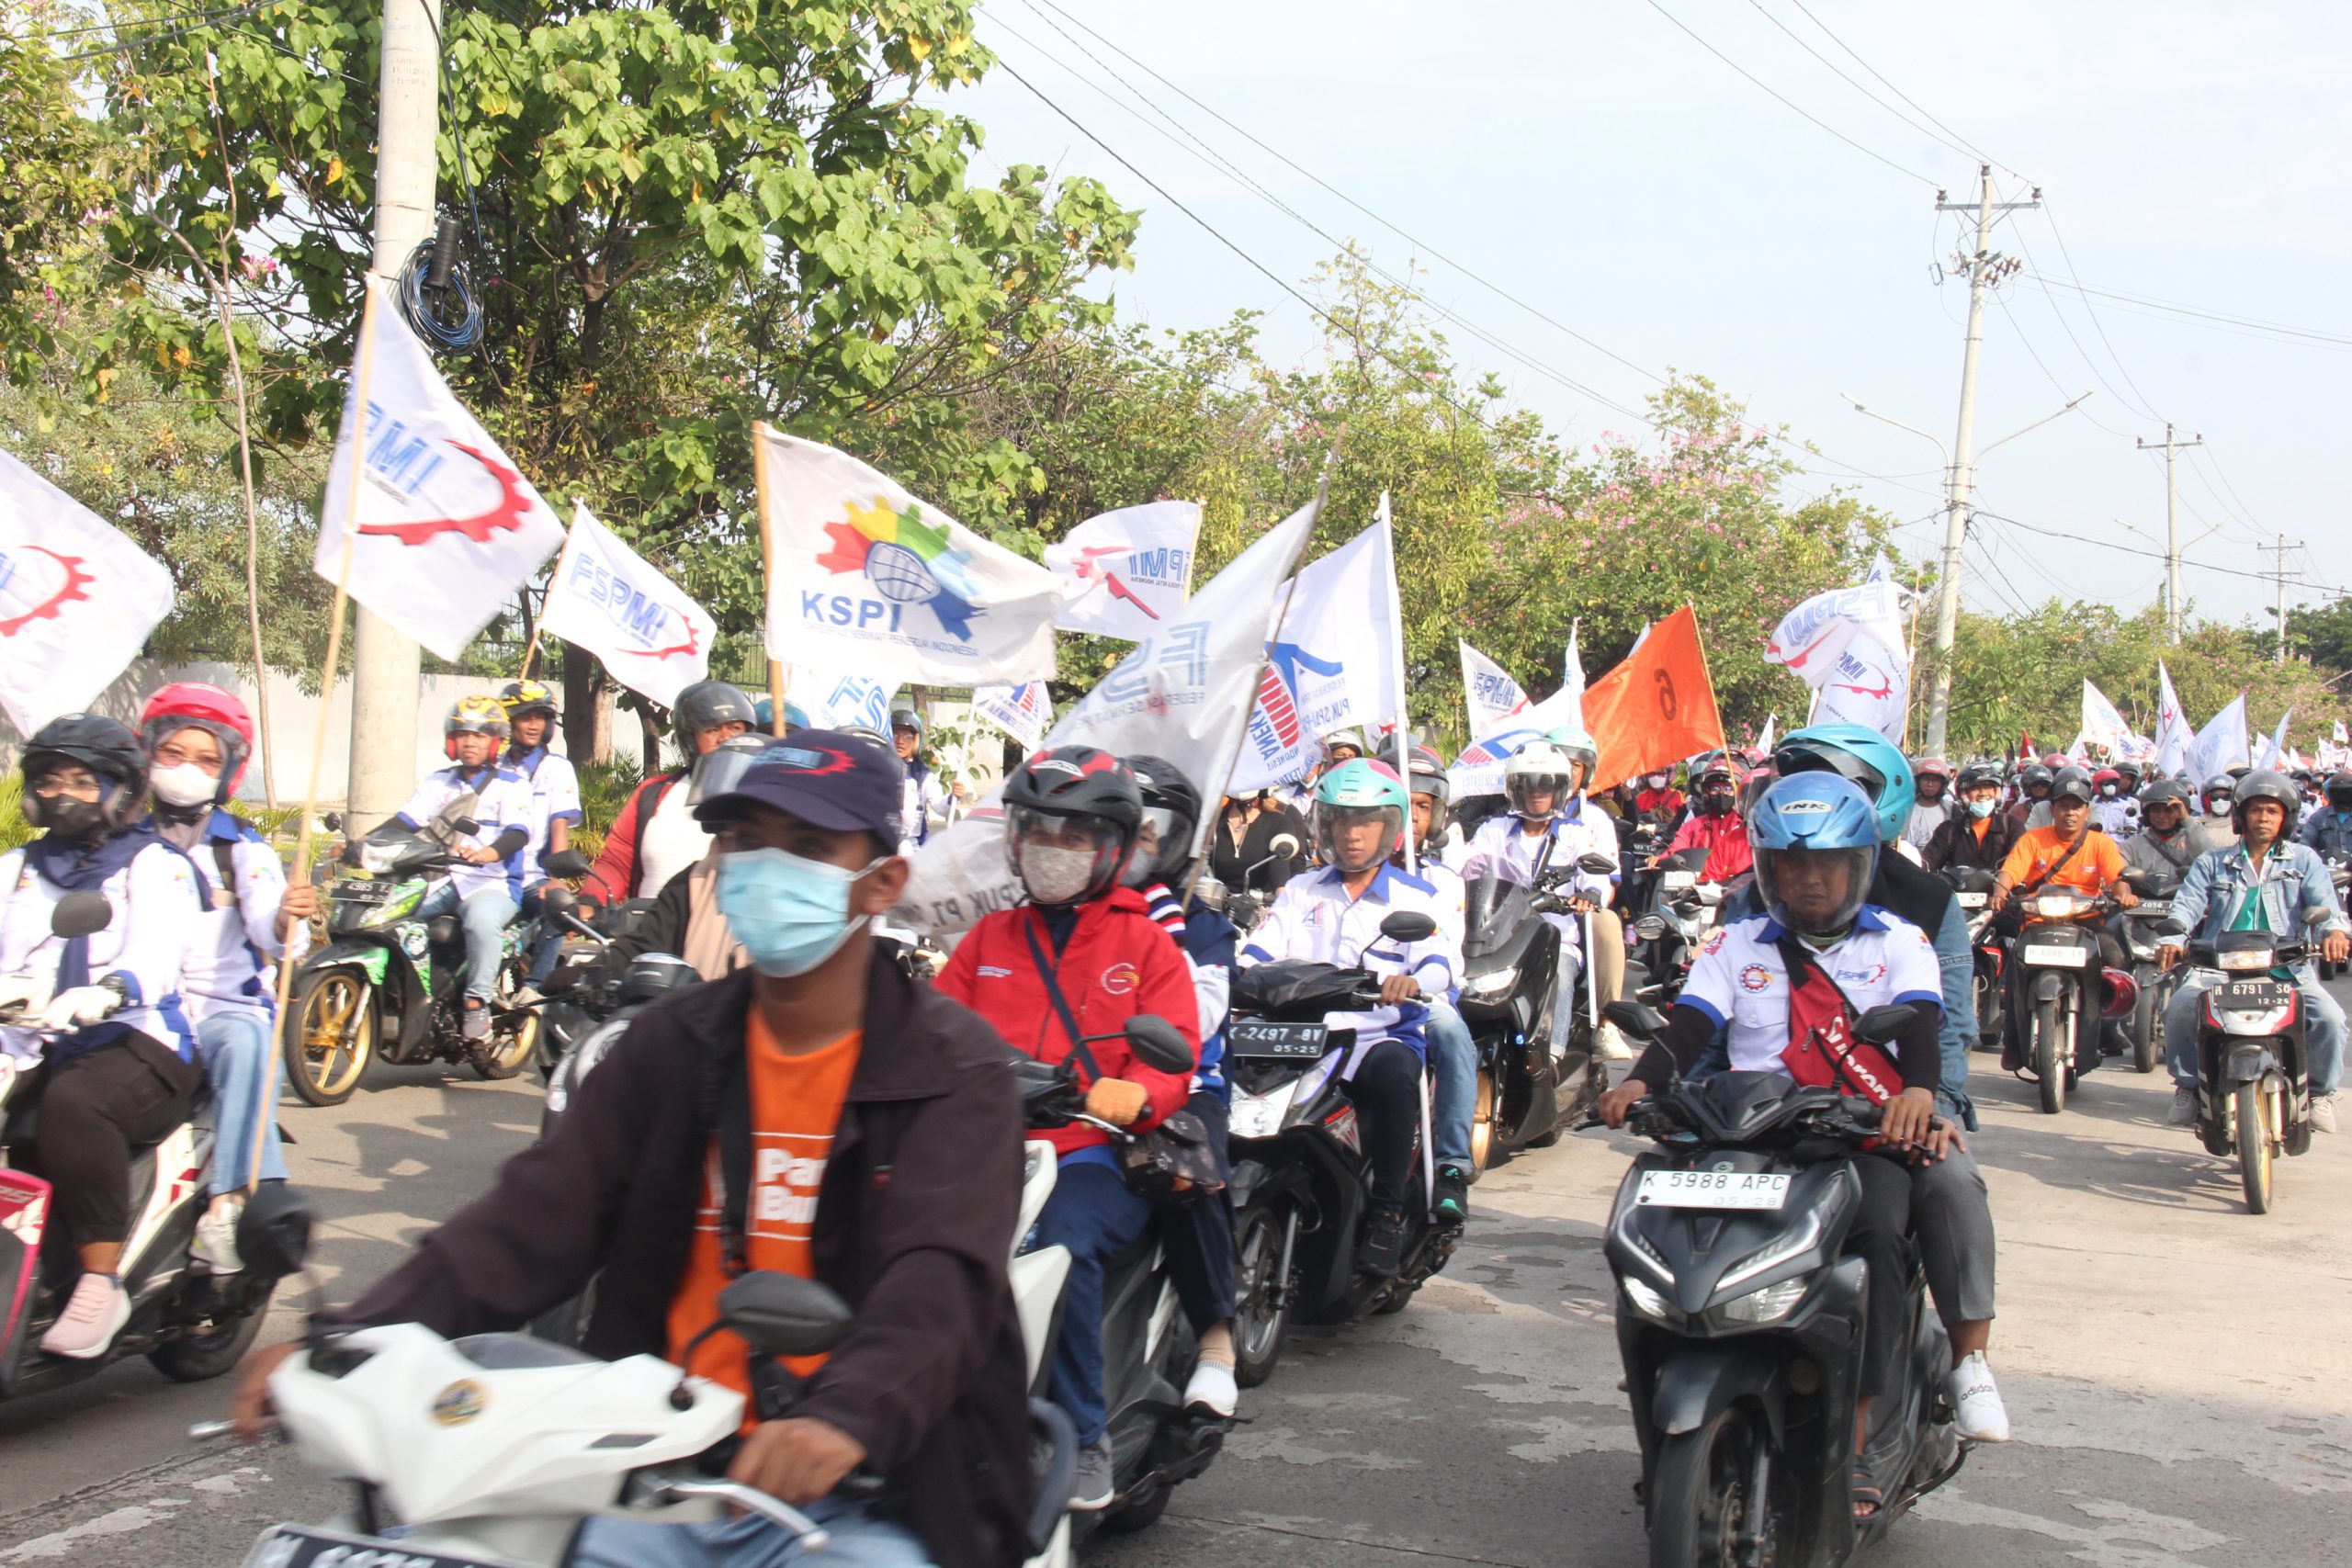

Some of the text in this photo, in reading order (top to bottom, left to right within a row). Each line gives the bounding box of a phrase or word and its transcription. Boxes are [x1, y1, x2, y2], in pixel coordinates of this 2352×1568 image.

[569, 552, 669, 641] FSPMI
[801, 590, 900, 633] KSPI
[1783, 803, 1826, 811] INK
[2233, 984, 2262, 995] 6791
[1247, 1026, 1290, 1041] 2497
[1272, 1044, 1318, 1054] 05-25
[1644, 1172, 1785, 1191] K 5988 APC
[1713, 1196, 1778, 1207] 05-28
